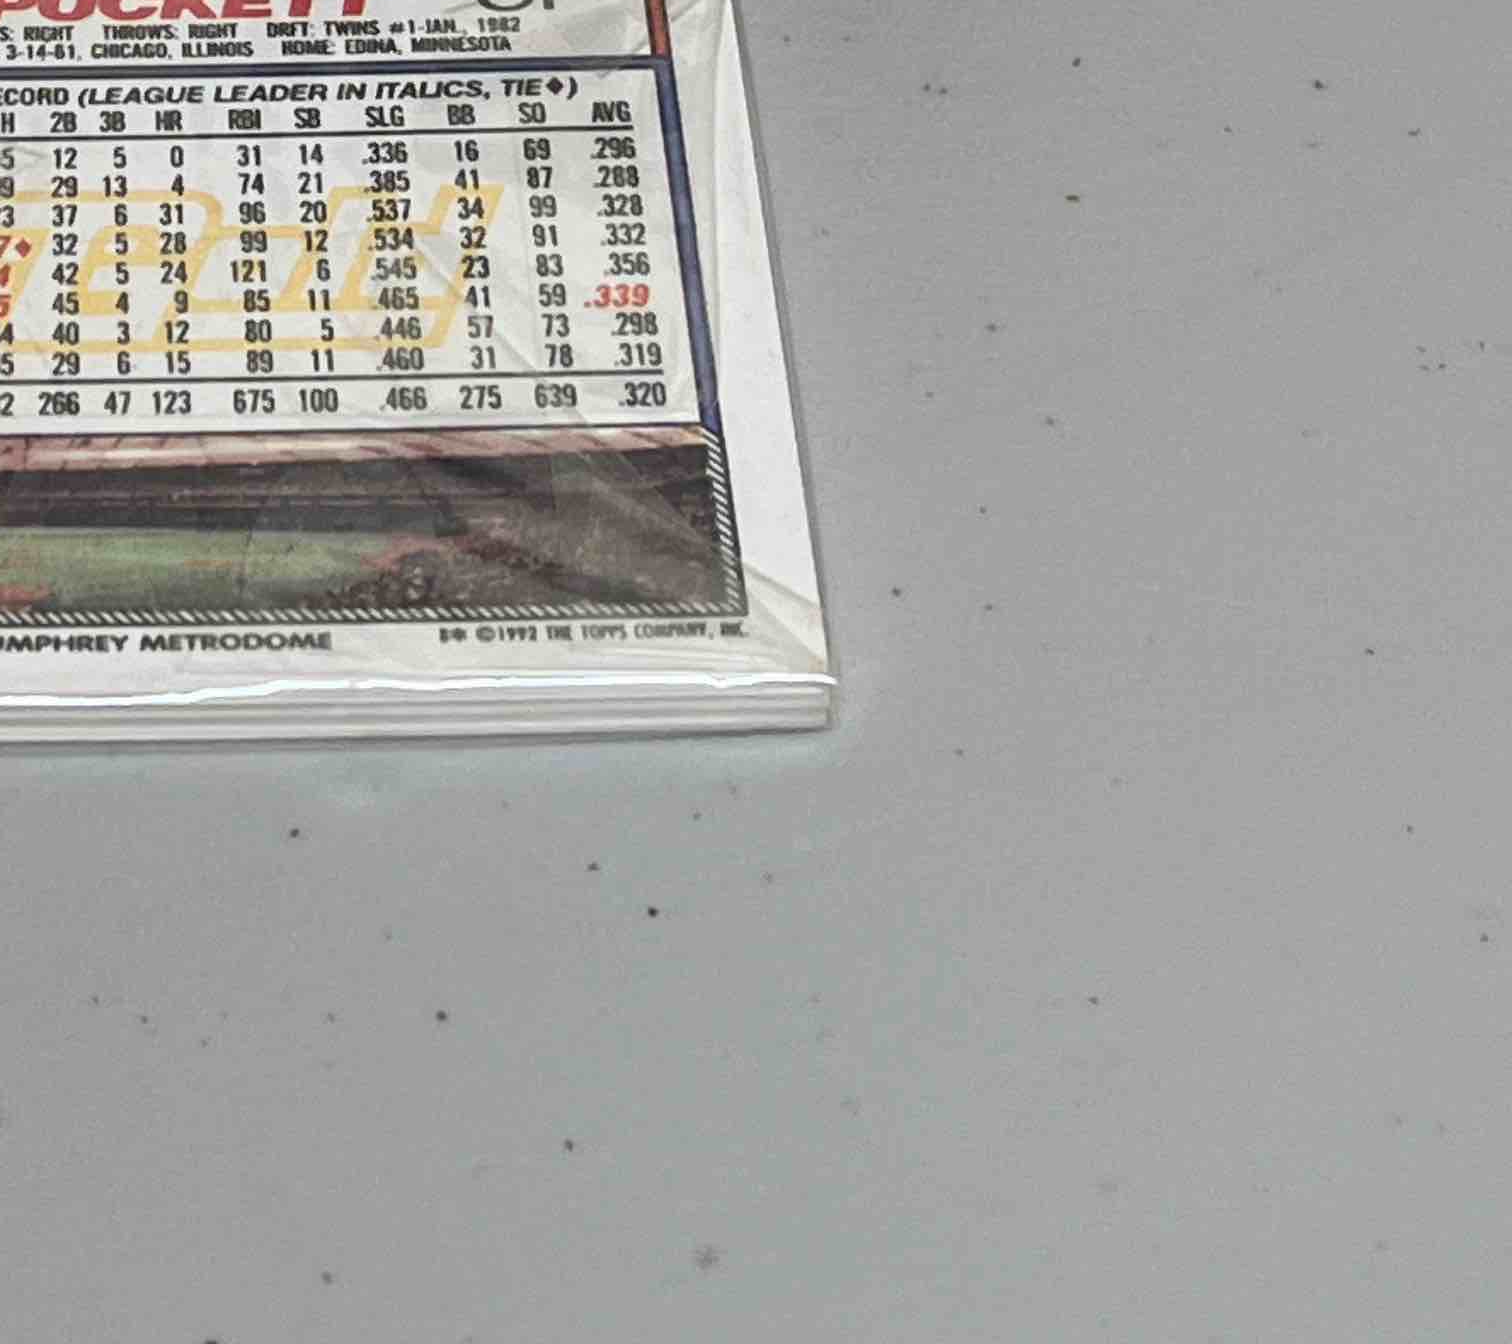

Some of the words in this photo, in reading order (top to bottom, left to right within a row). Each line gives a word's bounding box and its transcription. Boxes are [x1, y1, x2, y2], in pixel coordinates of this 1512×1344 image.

[102, 23, 179, 40] THROWS:
[267, 21, 315, 38] DRFT:
[324, 20, 381, 36] TWINS
[478, 16, 521, 33] 1982
[91, 42, 173, 60] CHICAGO,
[181, 41, 254, 57] ILLINOIS
[282, 40, 336, 57] HOME:
[345, 38, 403, 55] EDINA,
[411, 36, 512, 53] MINNESOTA
[78, 86, 205, 109] (LEAGUE
[213, 83, 328, 103] LEADER
[336, 82, 368, 101] IN
[375, 79, 490, 100] ITALICS,
[1, 112, 15, 134] H
[50, 111, 77, 133] 2B
[155, 109, 183, 132] HR
[228, 108, 261, 130] RBI
[294, 107, 322, 129] SB
[365, 104, 405, 128] SLG
[447, 103, 476, 126] BB
[518, 102, 546, 124] SO
[592, 100, 632, 123] AVG
[53, 147, 78, 170] 12
[113, 146, 127, 169] 5
[237, 144, 261, 167] 31
[299, 143, 324, 166] 14
[362, 141, 408, 165] .336
[454, 139, 479, 162] 16
[590, 136, 636, 160] .296
[52, 232, 78, 257] 32
[115, 232, 128, 256] 5
[160, 231, 187, 256] 28
[240, 229, 268, 253] 99
[304, 229, 328, 253] 12
[368, 226, 414, 251] .534
[459, 225, 487, 250] 32
[532, 224, 558, 247] 91
[601, 222, 646, 246] .332
[230, 259, 267, 283] 121
[584, 284, 649, 308] .339
[52, 350, 80, 376] 29
[117, 350, 131, 375] 6
[165, 350, 191, 375] 15
[246, 349, 274, 374] 89
[311, 348, 334, 372] 11
[376, 347, 424, 371] .460
[470, 345, 496, 370] 31
[545, 343, 574, 368] 78
[615, 342, 662, 367] .319
[38, 391, 80, 416] 266
[104, 391, 131, 416] 47
[152, 390, 191, 416] 123
[233, 389, 275, 415] 675
[299, 388, 339, 413] 100
[380, 386, 428, 411] .466
[459, 385, 502, 410] 275
[535, 383, 577, 408] 639
[619, 381, 667, 408] .320
[139, 631, 332, 652] METRODOME
[545, 624, 573, 641] THE
[580, 623, 627, 641] TOPPS
